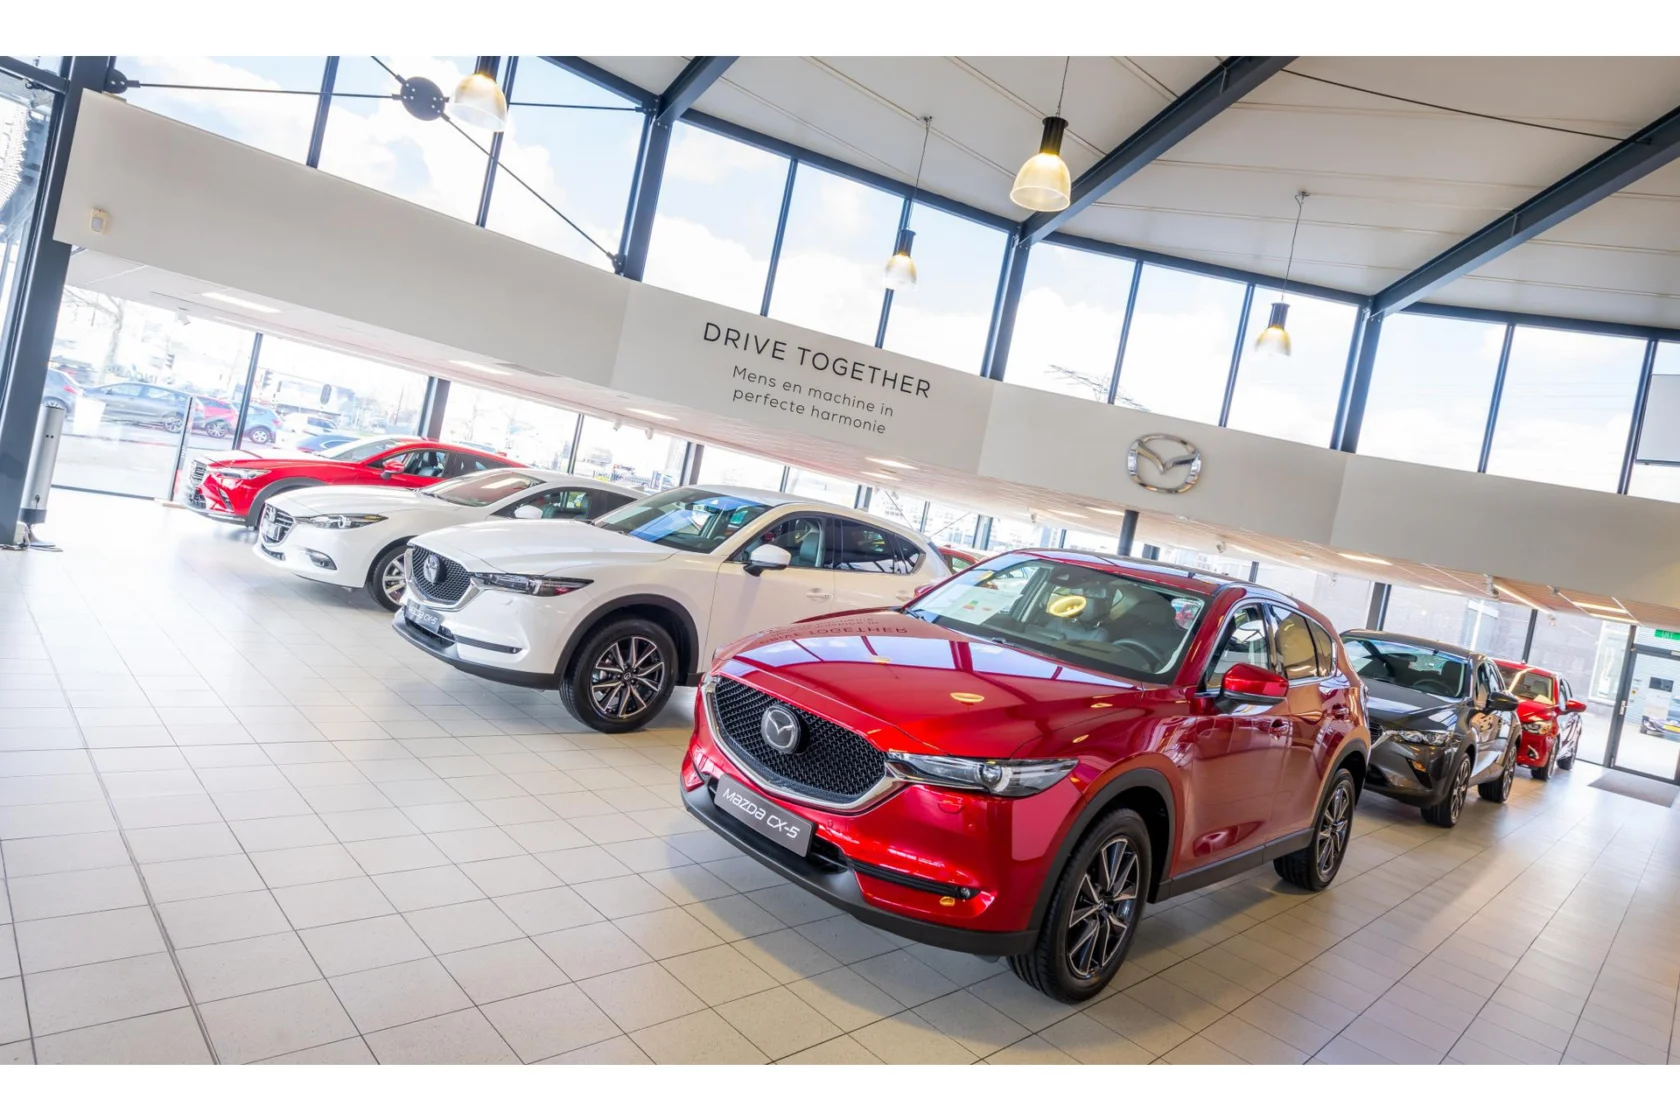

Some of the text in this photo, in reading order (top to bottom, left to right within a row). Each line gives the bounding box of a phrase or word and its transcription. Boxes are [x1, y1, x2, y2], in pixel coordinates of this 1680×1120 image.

[703, 322, 931, 398] DRIVE TOGETHER
[732, 365, 893, 417] Mens en machine in
[732, 387, 886, 434] perfecte harmonie
[766, 814, 800, 839] CX-5
